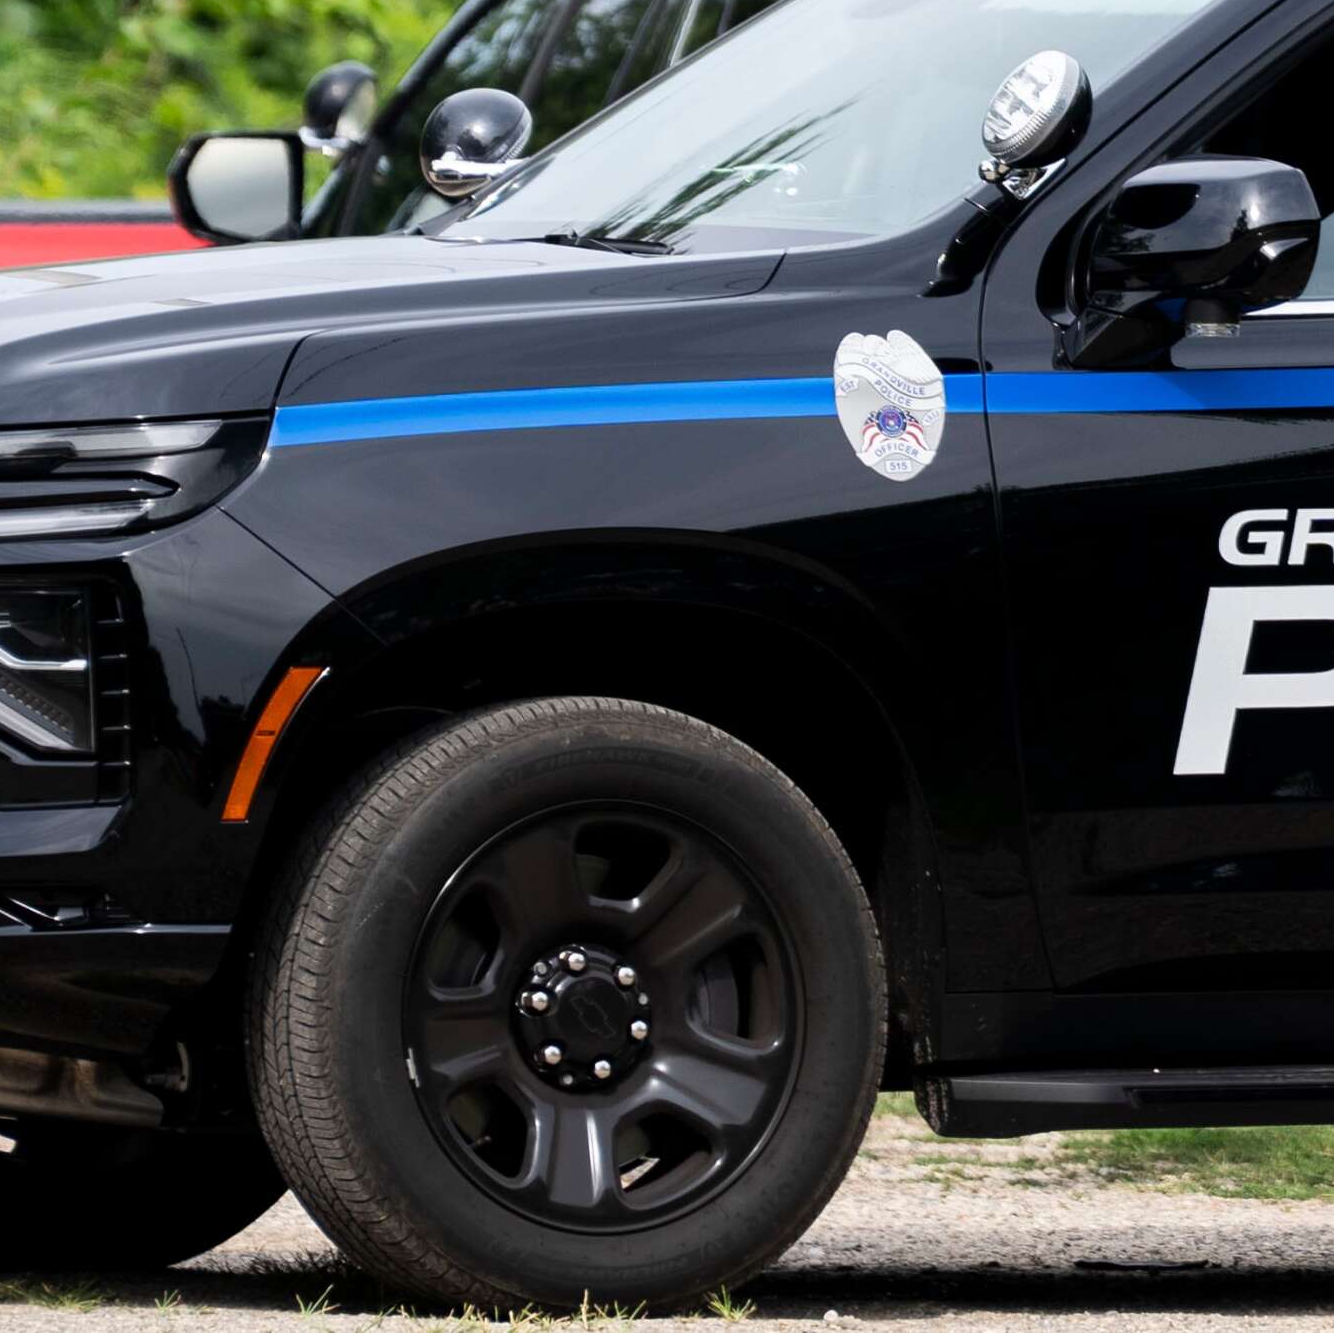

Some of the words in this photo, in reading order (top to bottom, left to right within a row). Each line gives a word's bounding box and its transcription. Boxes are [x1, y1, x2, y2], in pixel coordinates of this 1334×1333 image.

[861, 357, 927, 396] GRANDVILLE
[874, 379, 913, 407] POLICE
[874, 442, 919, 458] OFFICER
[889, 461, 908, 471] 515
